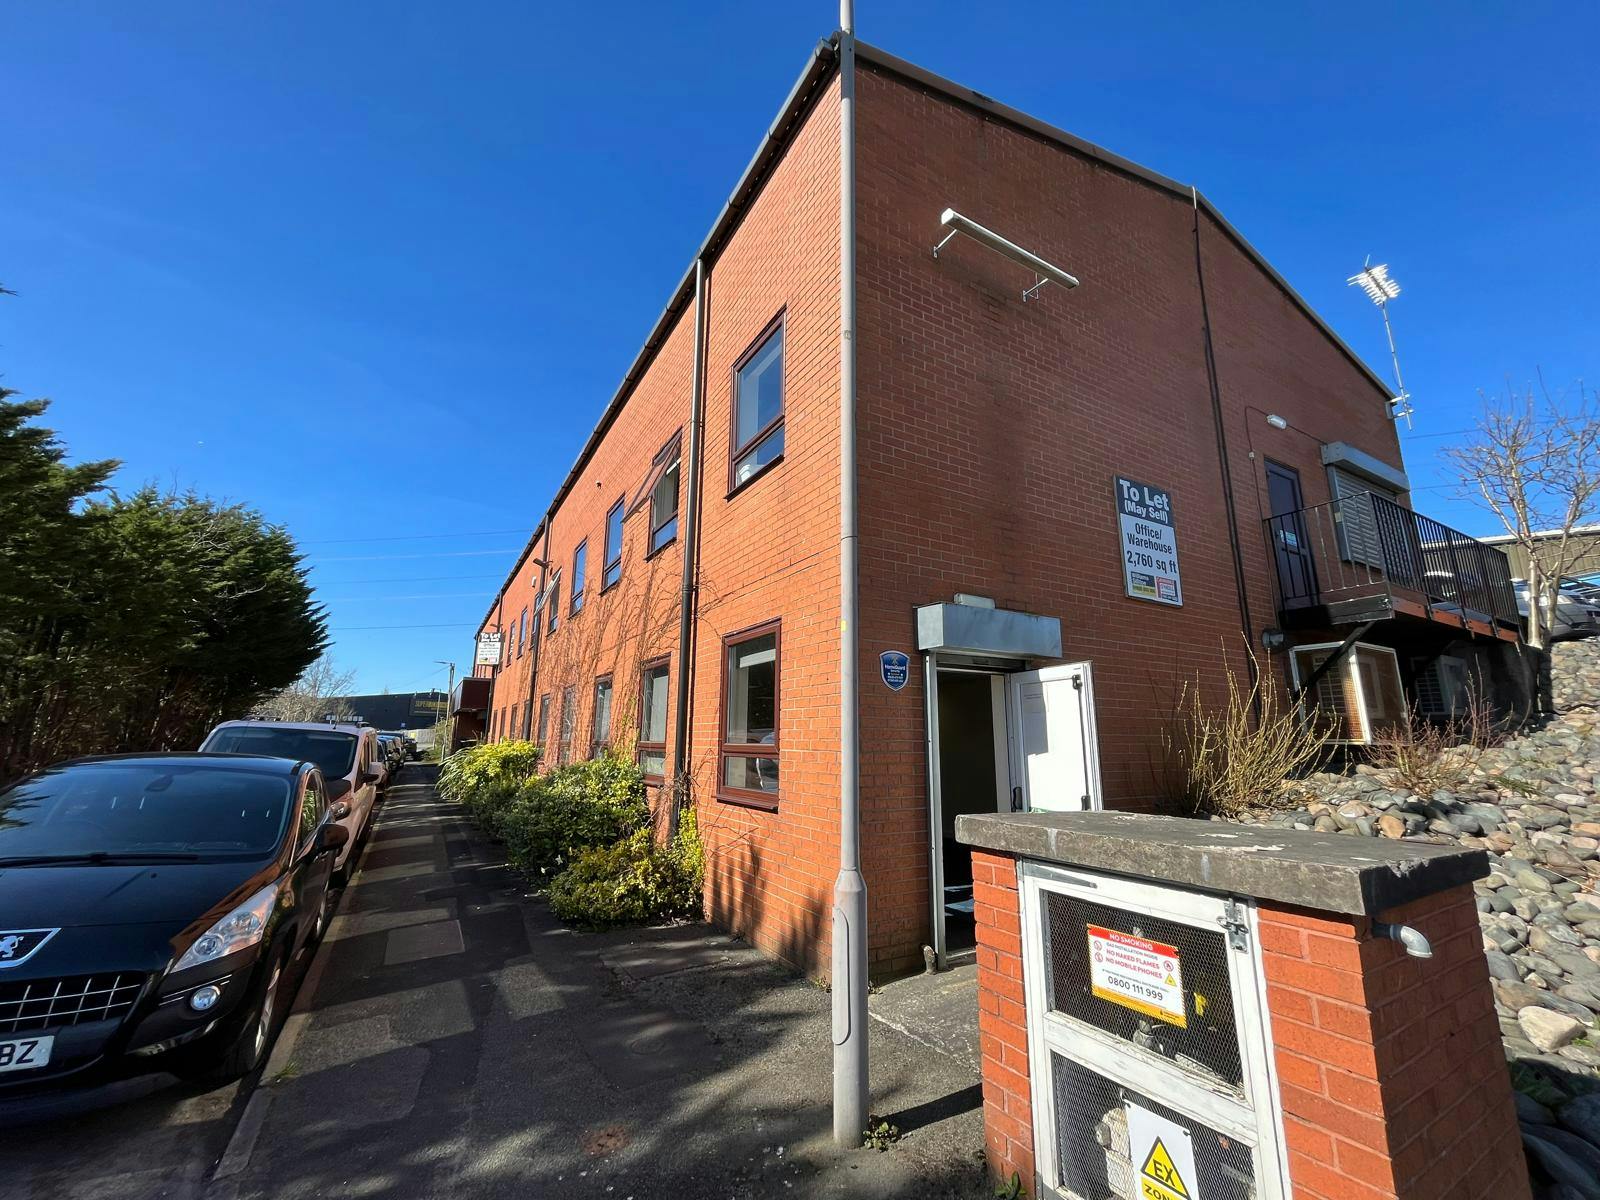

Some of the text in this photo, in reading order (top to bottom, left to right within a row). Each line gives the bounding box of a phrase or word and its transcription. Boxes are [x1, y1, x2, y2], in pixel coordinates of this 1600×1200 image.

[1119, 479, 1170, 511] To Let
[1125, 501, 1168, 524] (May Sell)
[1135, 523, 1162, 540] Office/
[1127, 532, 1173, 555] Warehouse
[1126, 550, 1177, 574] 2,760 sq ft
[1109, 933, 1153, 950] NO SMOKING
[1115, 960, 1137, 971] MOBILE
[1137, 966, 1163, 979] PHONES
[1116, 951, 1135, 962] NAKED
[1136, 957, 1160, 970] FLAMES
[1108, 975, 1130, 990] 0800
[1132, 984, 1145, 995] 111
[1146, 987, 1163, 1001] 999
[1153, 1158, 1176, 1187] EX
[1144, 1183, 1170, 1200] ZON
